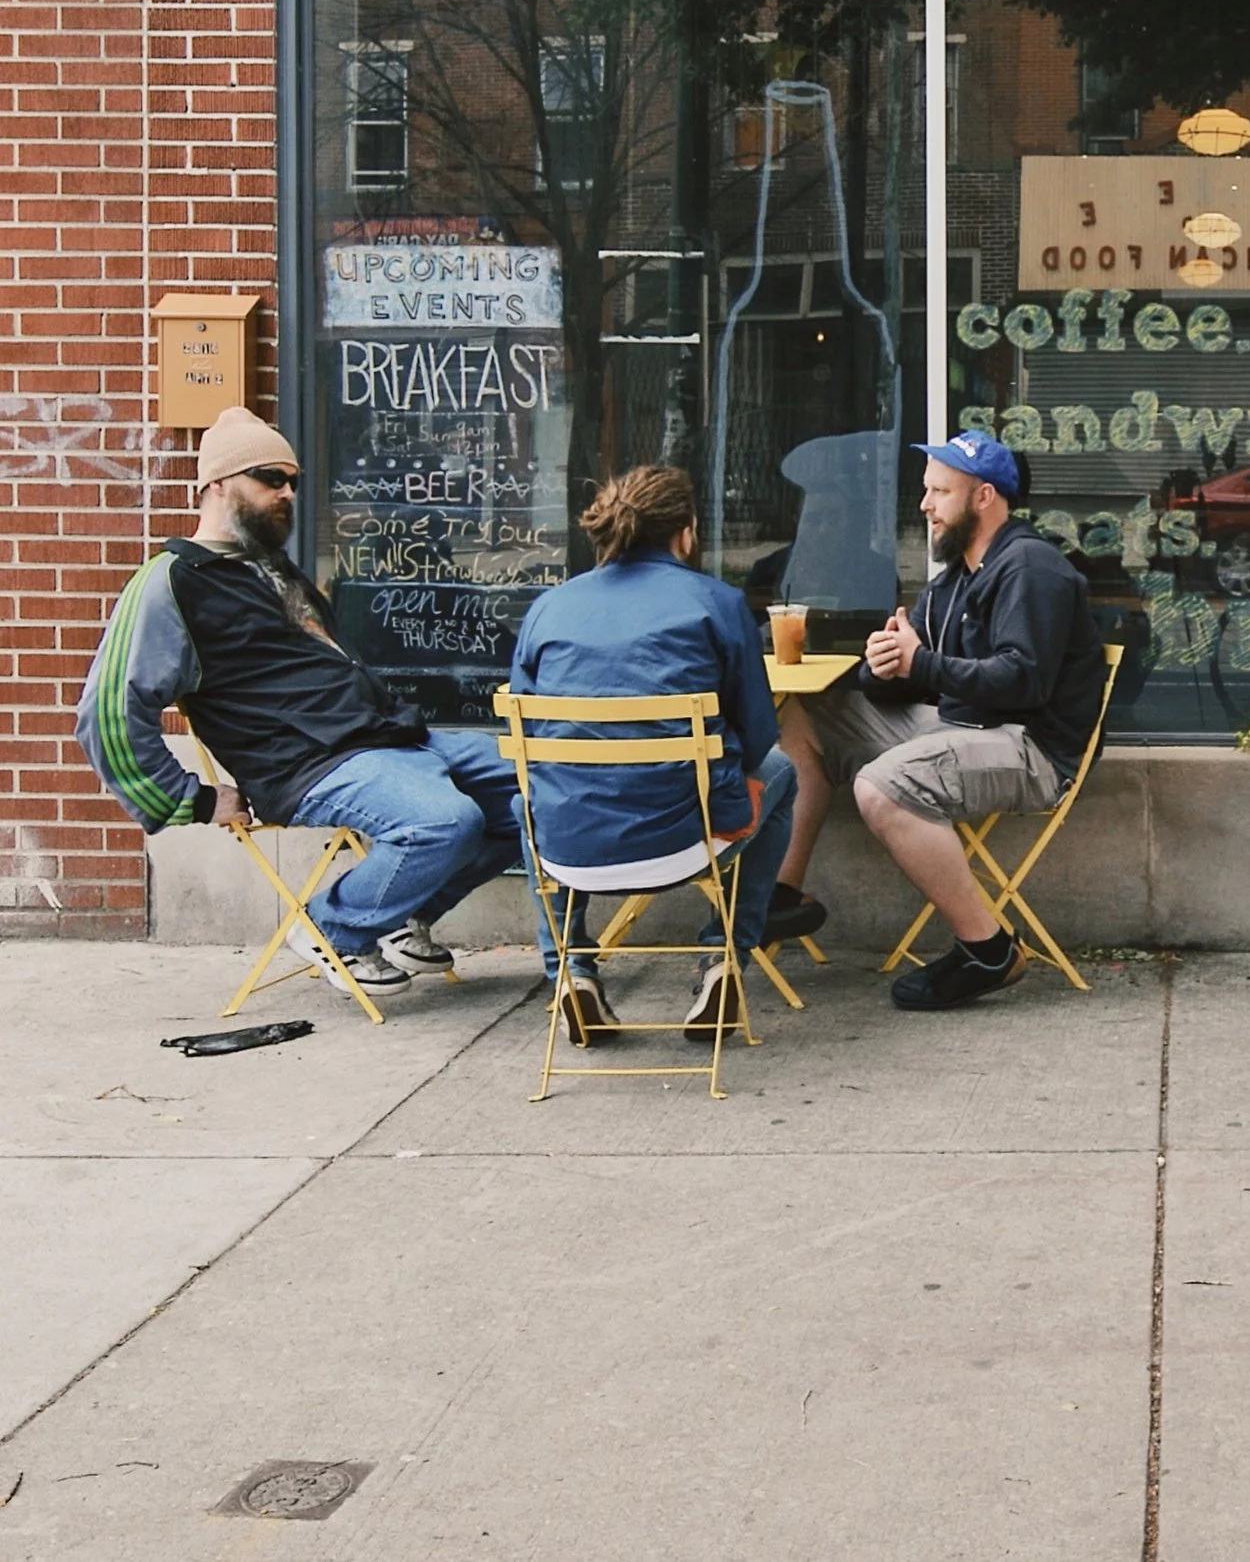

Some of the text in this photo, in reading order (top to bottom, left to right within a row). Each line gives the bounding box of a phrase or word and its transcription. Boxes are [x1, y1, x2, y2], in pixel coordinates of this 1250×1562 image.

[336, 252, 540, 284] UPCOMING
[370, 292, 526, 325] EVENTS
[340, 340, 558, 412] BREAKFAST
[384, 414, 408, 434] Fri
[418, 424, 451, 442] Sun
[405, 469, 488, 504] BEER
[336, 513, 430, 537] Come
[498, 521, 548, 546] our
[371, 588, 510, 627] open mic
[392, 616, 426, 631] EVERY
[394, 629, 501, 656] THURSDAY
